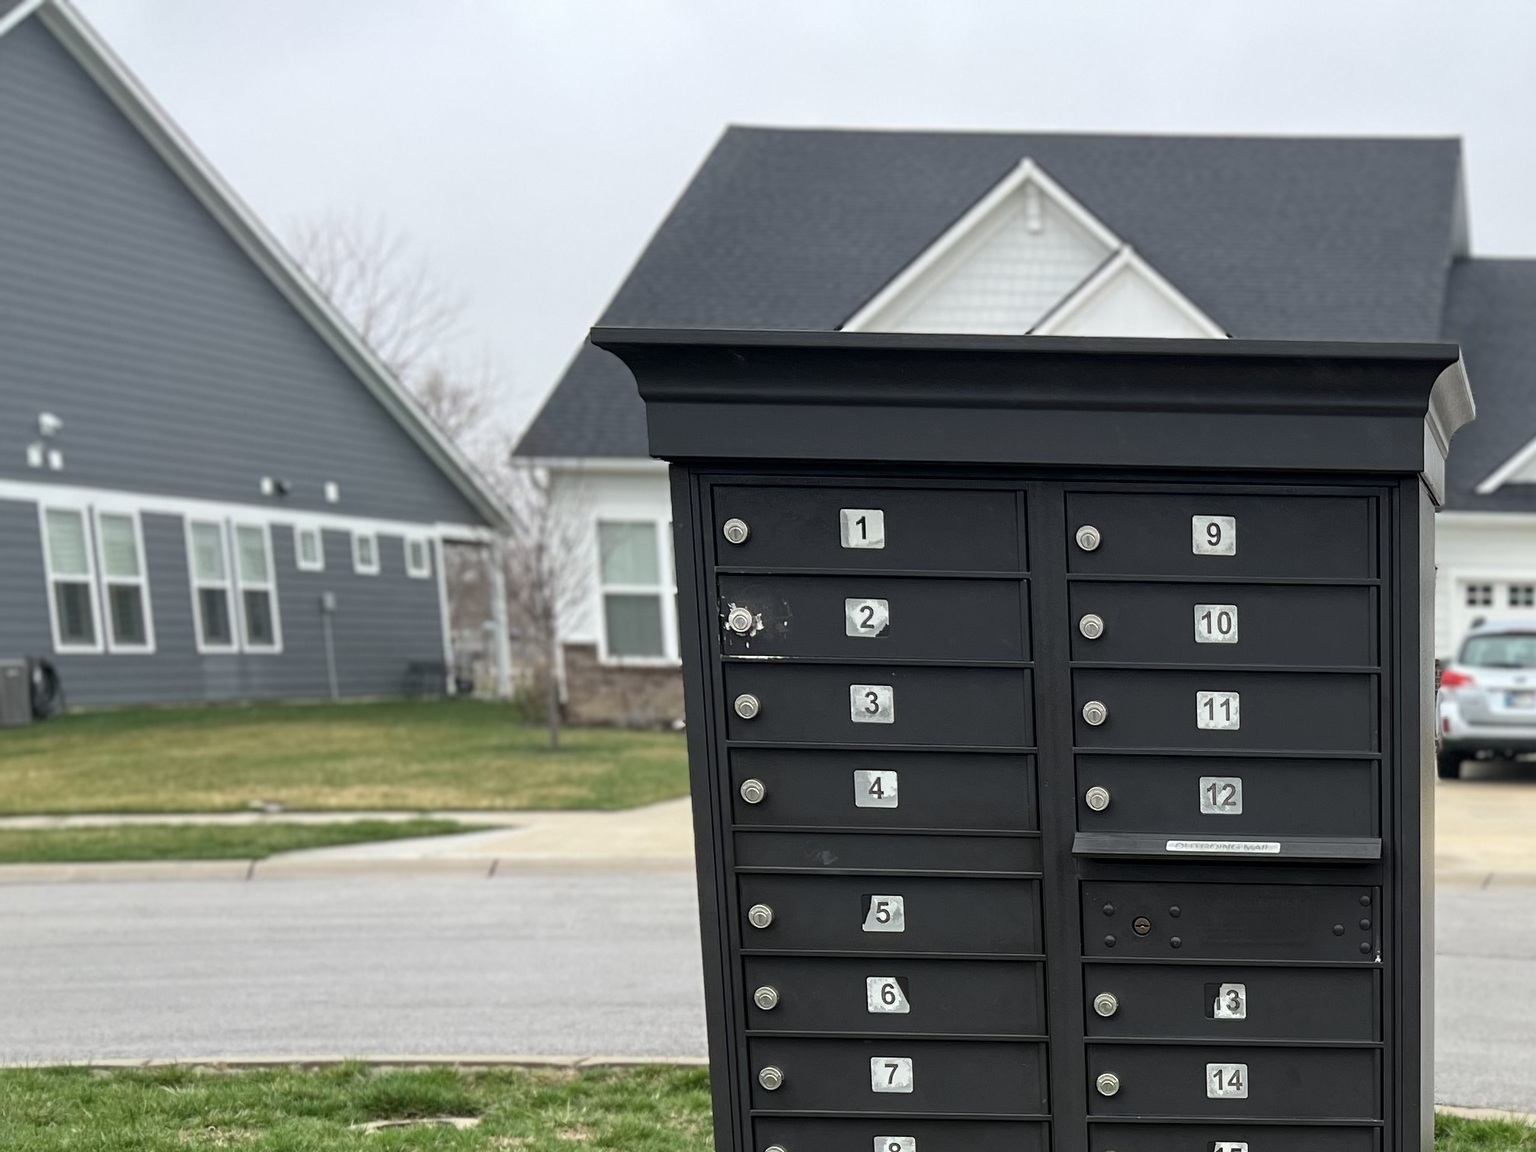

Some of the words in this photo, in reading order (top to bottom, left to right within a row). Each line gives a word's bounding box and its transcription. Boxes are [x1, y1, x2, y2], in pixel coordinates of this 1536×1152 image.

[856, 516, 866, 539] 1
[1206, 523, 1221, 546] 9
[859, 606, 875, 629] 2
[1201, 611, 1231, 635] 10
[864, 692, 879, 714] 3
[1203, 698, 1230, 721] 11
[869, 777, 884, 799] 4
[1207, 783, 1237, 806] 12
[876, 902, 890, 923] 5
[881, 983, 896, 1005] 6
[884, 1064, 898, 1084] 7
[1213, 1069, 1243, 1090] 14
